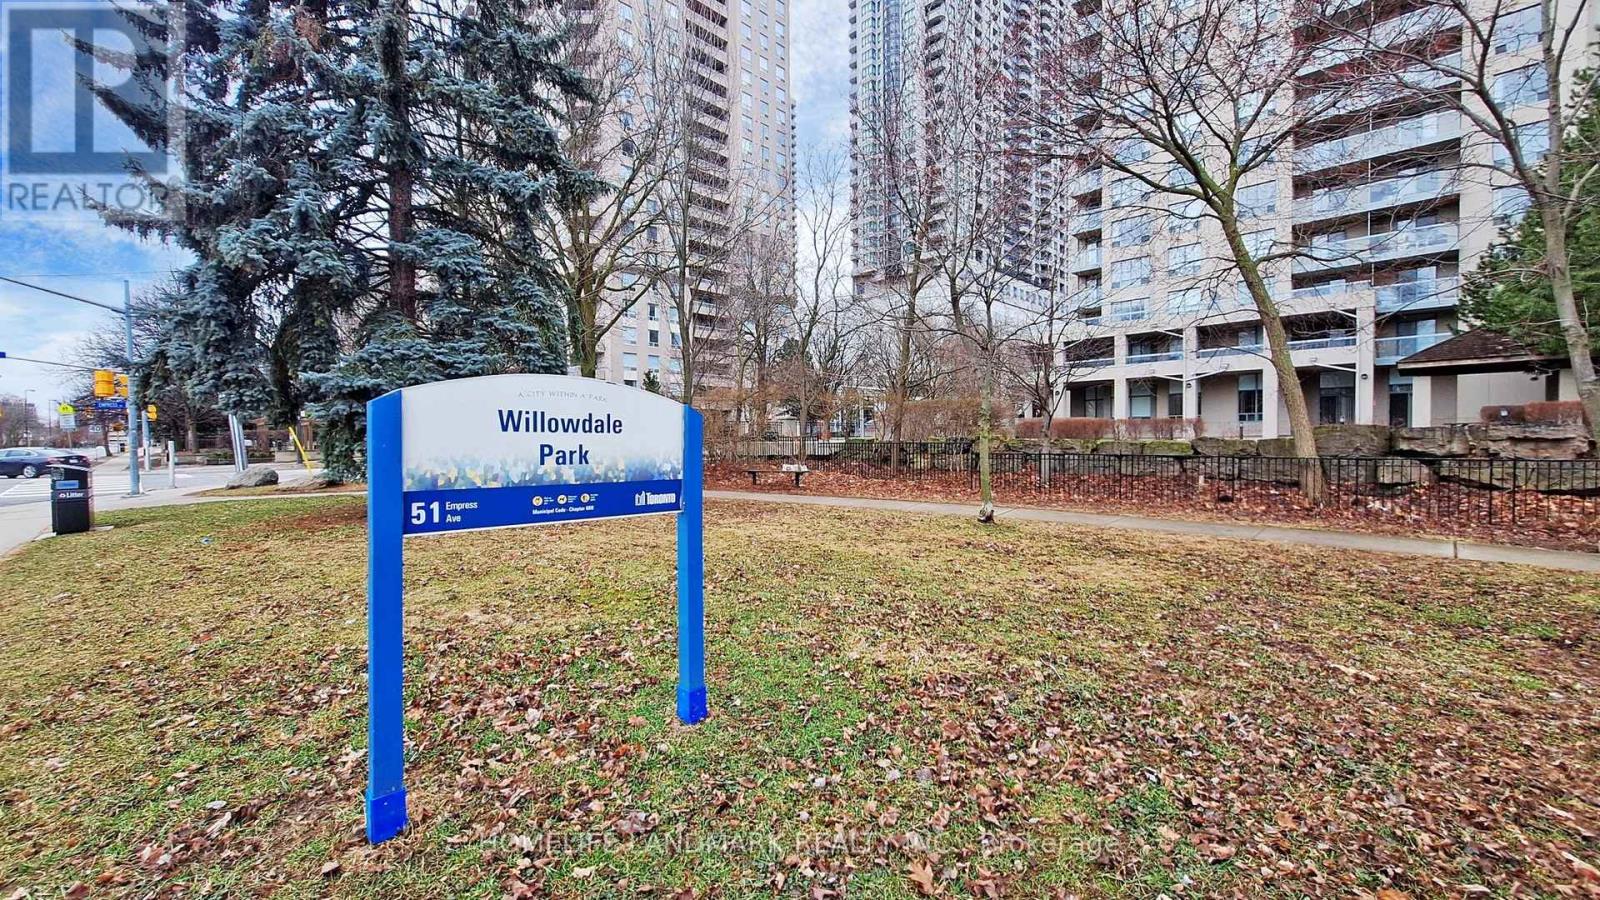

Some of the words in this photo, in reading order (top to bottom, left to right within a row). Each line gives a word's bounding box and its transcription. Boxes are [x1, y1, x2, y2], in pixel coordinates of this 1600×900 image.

[549, 390, 578, 399] WITHIN
[498, 409, 623, 434] Willowdale
[539, 444, 590, 466] Park
[411, 501, 440, 525] 51
[445, 501, 478, 511] Empress
[445, 514, 461, 523] Ave
